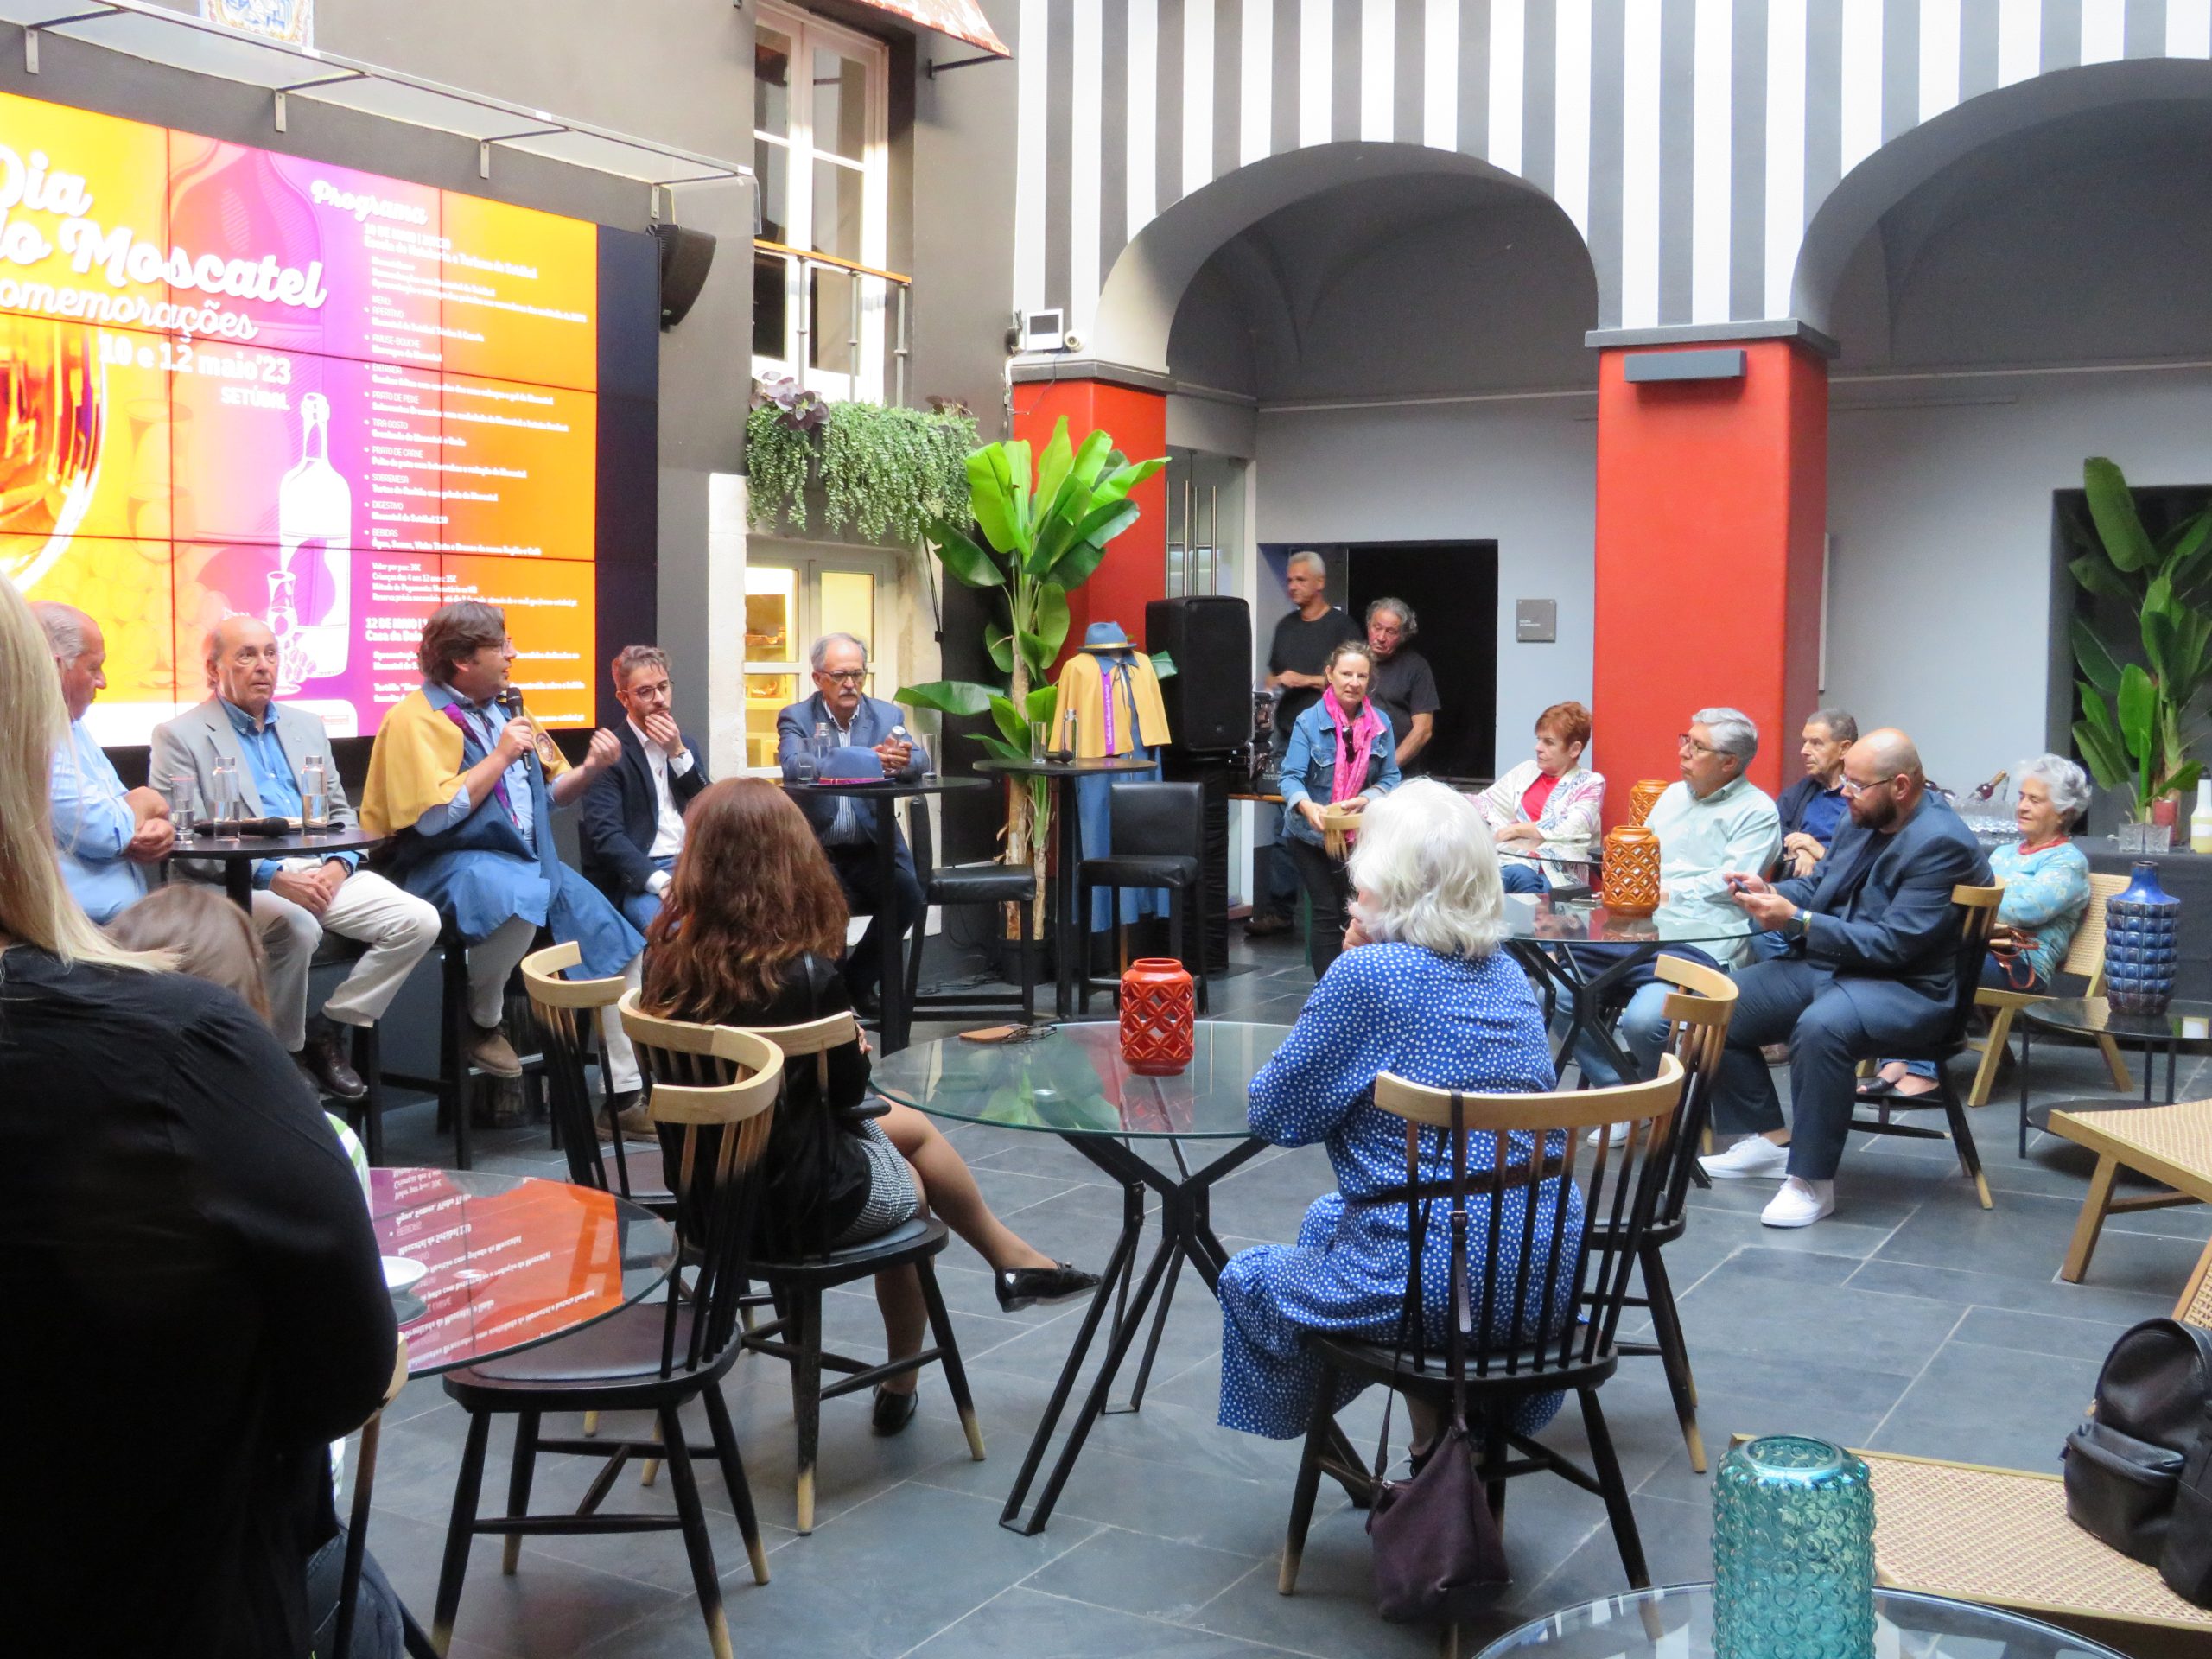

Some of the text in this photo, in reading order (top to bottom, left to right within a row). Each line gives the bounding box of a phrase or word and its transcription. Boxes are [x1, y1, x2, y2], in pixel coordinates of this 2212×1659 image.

[311, 179, 428, 225] Programa
[0, 209, 52, 264] o
[59, 217, 328, 308] Moscatel
[0, 278, 258, 343] omemorações
[98, 334, 134, 365] 10
[137, 345, 155, 368] e
[160, 343, 193, 372] 12
[220, 385, 290, 410] SETÚBAL
[365, 617, 378, 628] 12
[378, 618, 391, 628] DE
